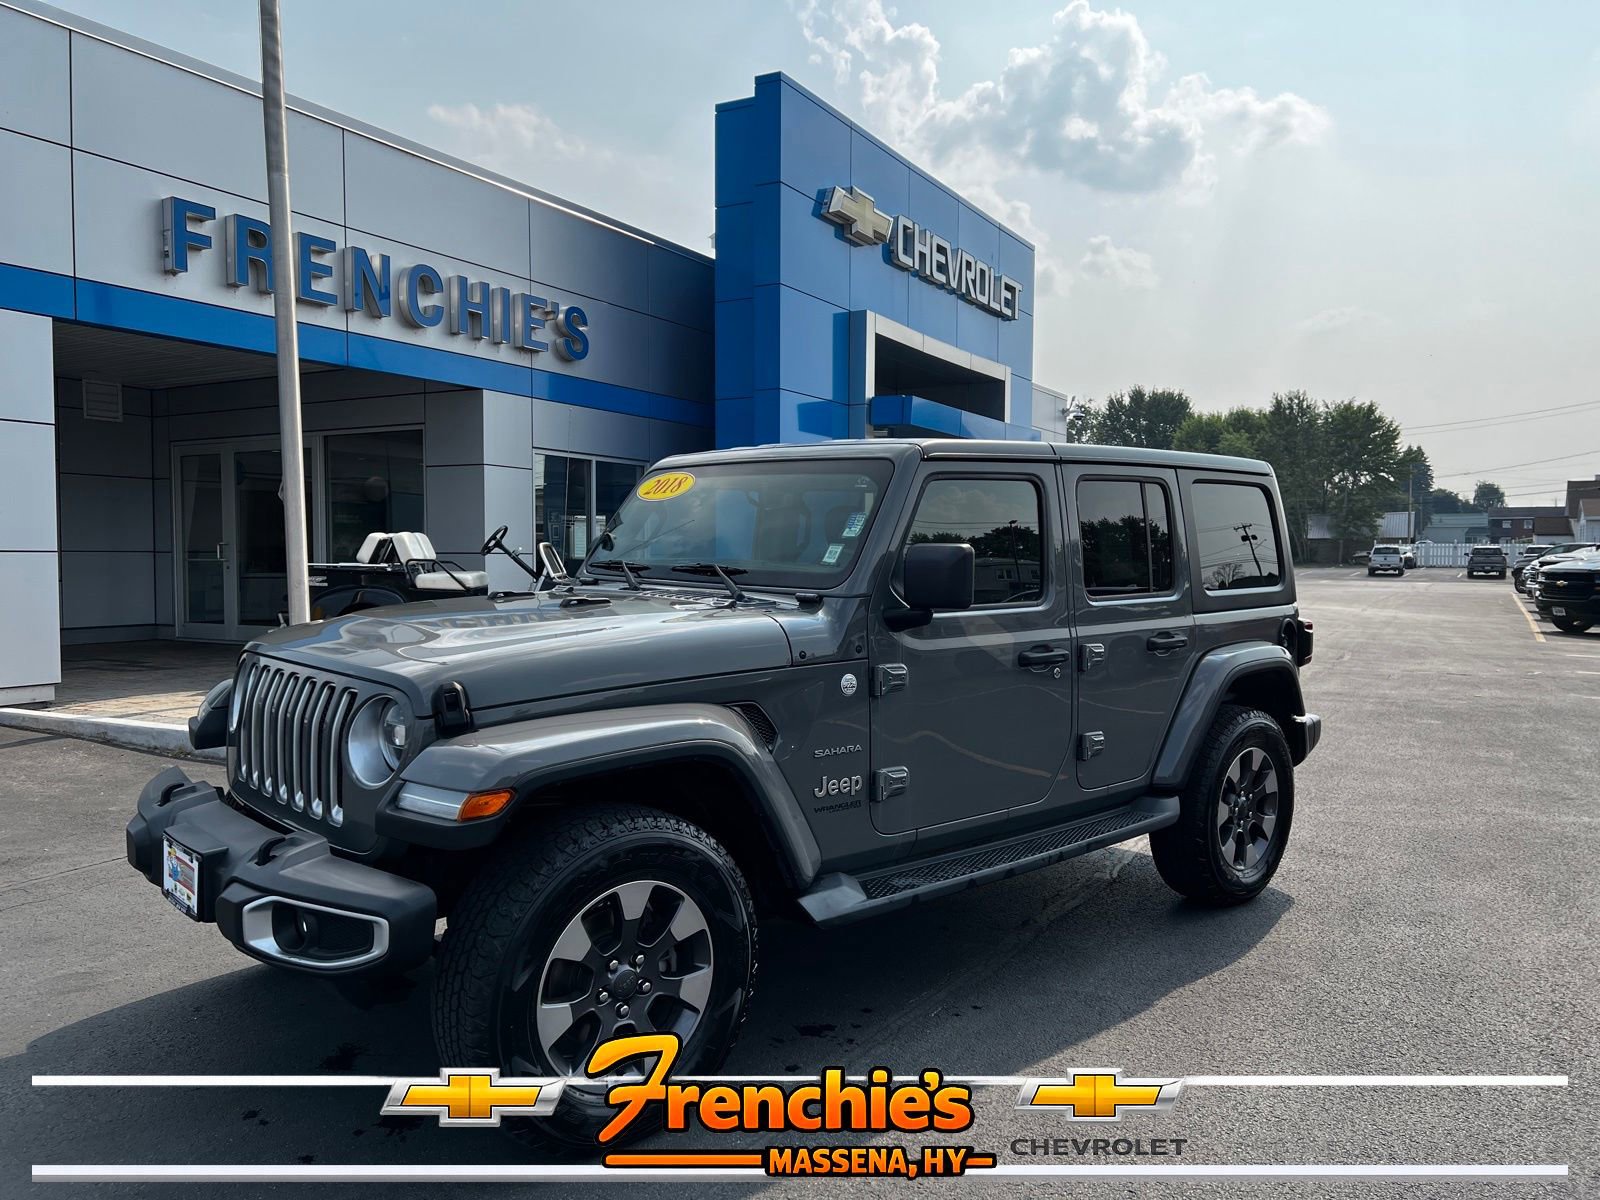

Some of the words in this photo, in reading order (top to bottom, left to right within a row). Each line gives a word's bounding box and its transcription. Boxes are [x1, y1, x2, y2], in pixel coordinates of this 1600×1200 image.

[163, 196, 590, 361] FRENCHIE'S
[893, 214, 1024, 320] CHEVROLET
[642, 476, 689, 496] 2018
[814, 744, 863, 758] SAHARA
[814, 775, 863, 798] Jeep
